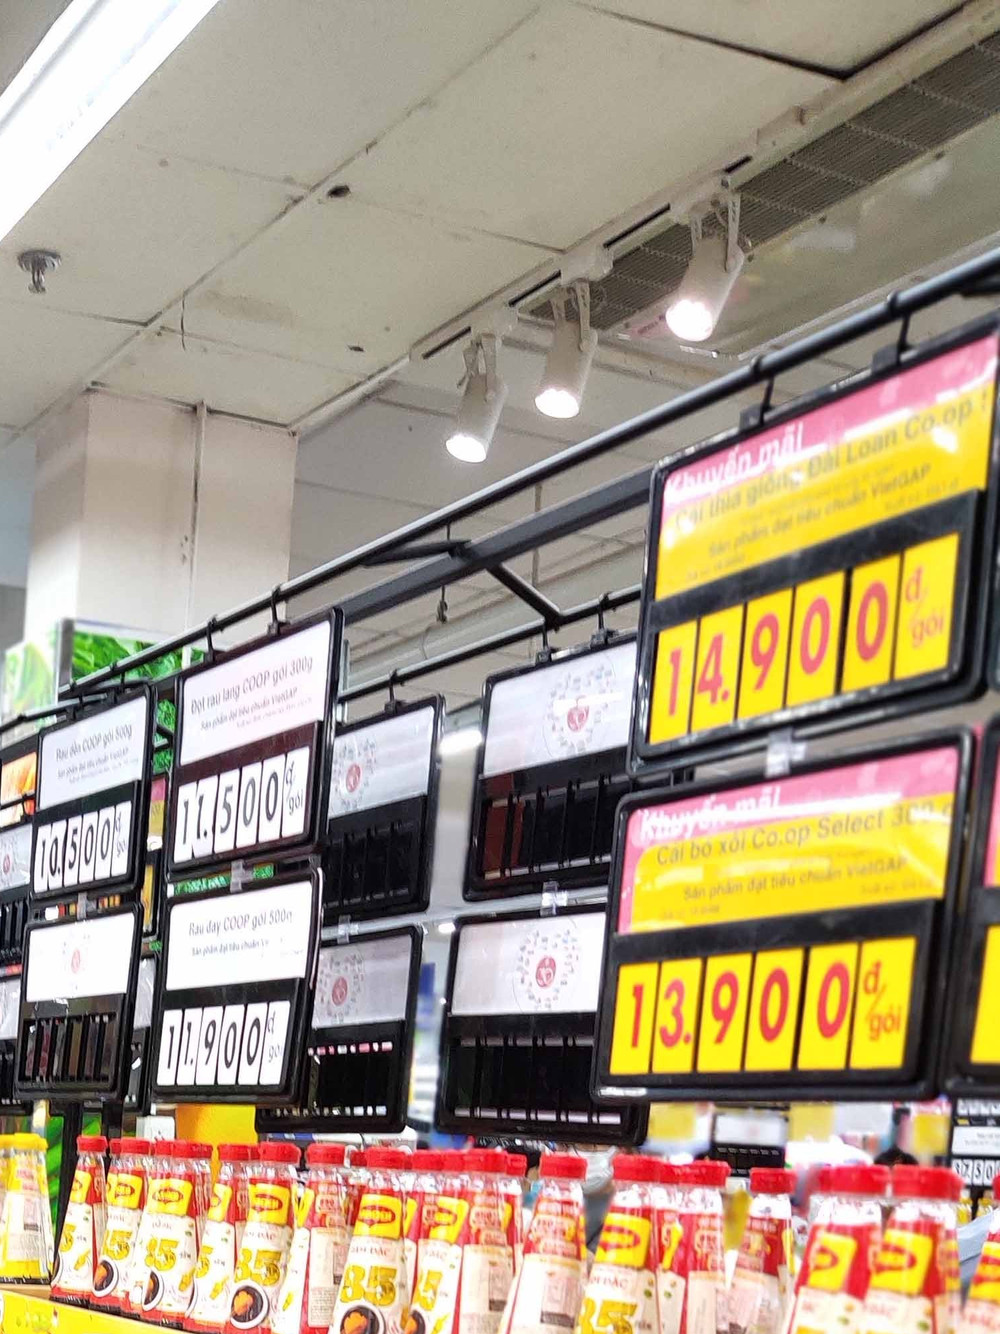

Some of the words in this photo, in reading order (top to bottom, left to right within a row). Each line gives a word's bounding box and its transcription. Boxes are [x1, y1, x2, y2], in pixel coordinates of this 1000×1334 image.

[846, 429, 899, 460] Loan
[904, 399, 974, 442] Co.op
[669, 580, 889, 717] 14.900
[242, 669, 271, 694] COOP
[182, 770, 279, 845] 11.500
[751, 824, 811, 852] Co.op
[817, 809, 884, 840] Select
[41, 816, 111, 879] 10.500
[223, 913, 250, 933] COOP
[631, 960, 851, 1049] 13.900
[167, 1016, 261, 1070] 11.900
